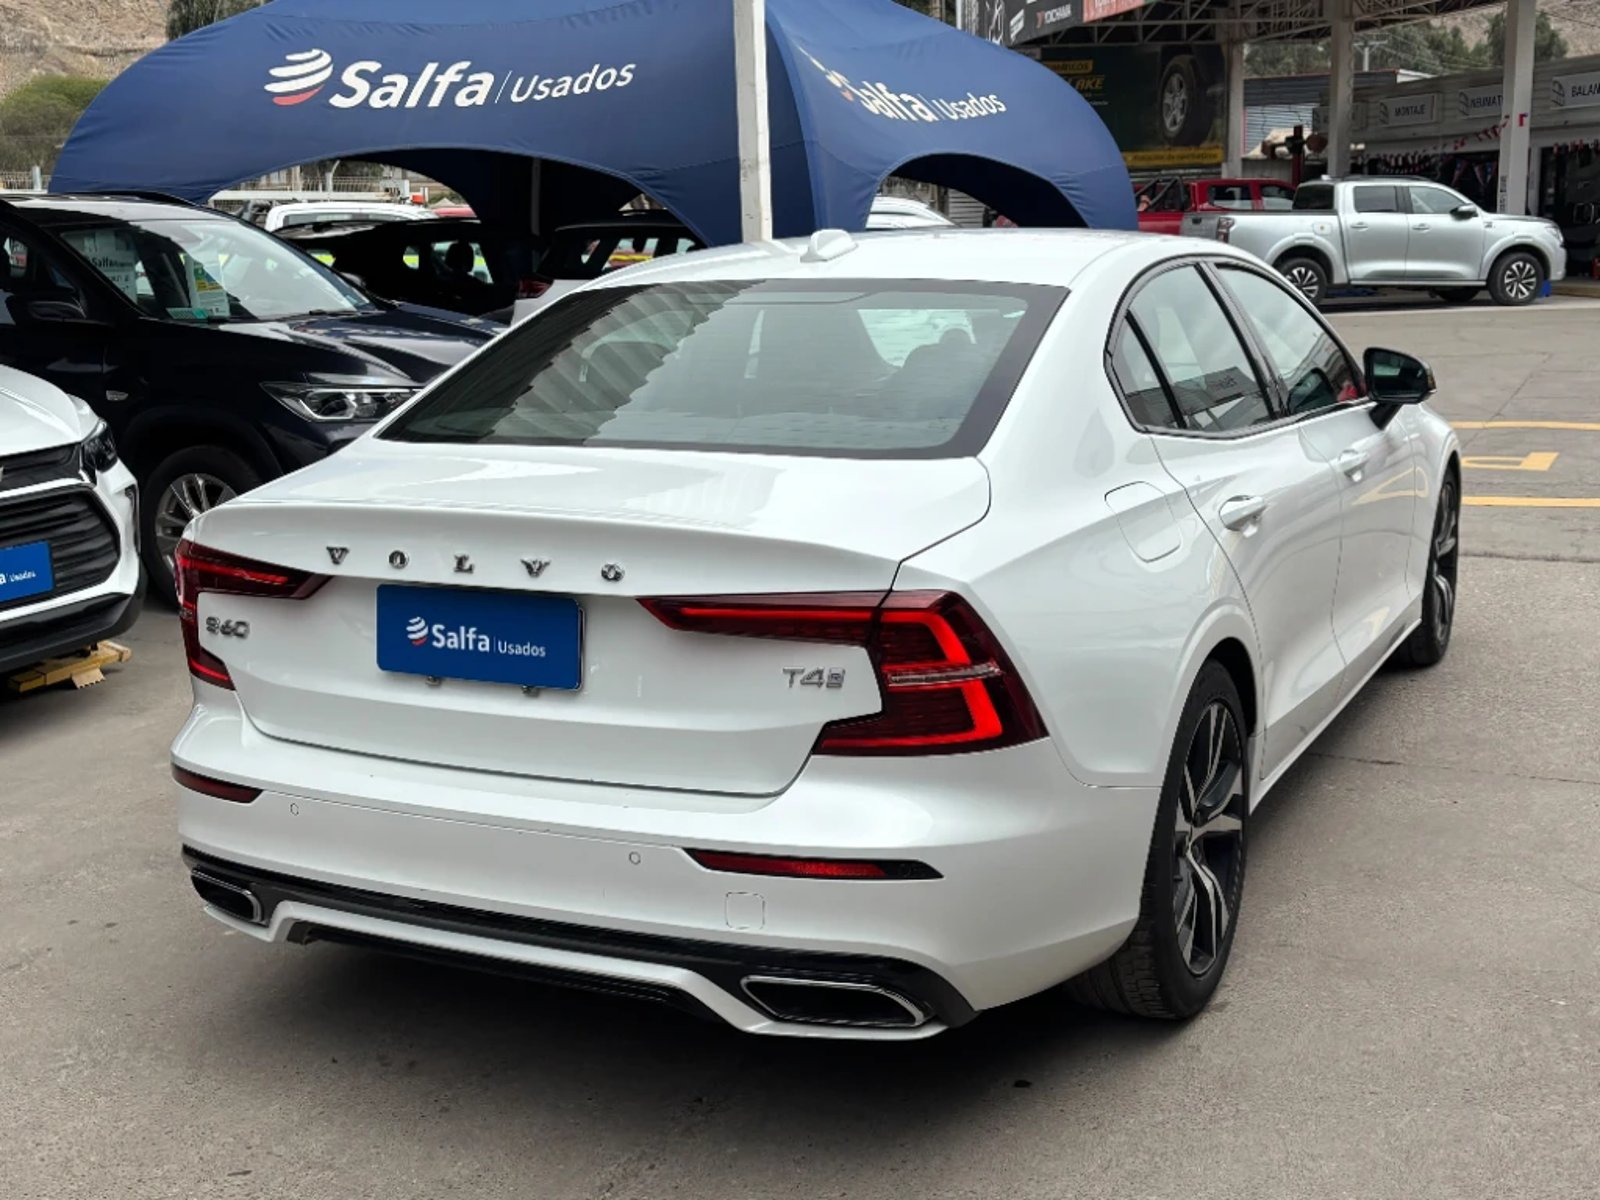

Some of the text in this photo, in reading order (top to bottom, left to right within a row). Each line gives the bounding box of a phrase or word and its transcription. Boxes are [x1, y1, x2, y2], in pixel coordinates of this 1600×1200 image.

[329, 60, 636, 109] Salfa Usados
[857, 81, 1007, 122] Salfa Usados
[1394, 104, 1425, 116] MONTAJE
[326, 546, 625, 582] VOLVO
[432, 624, 546, 657] Salfa Usados
